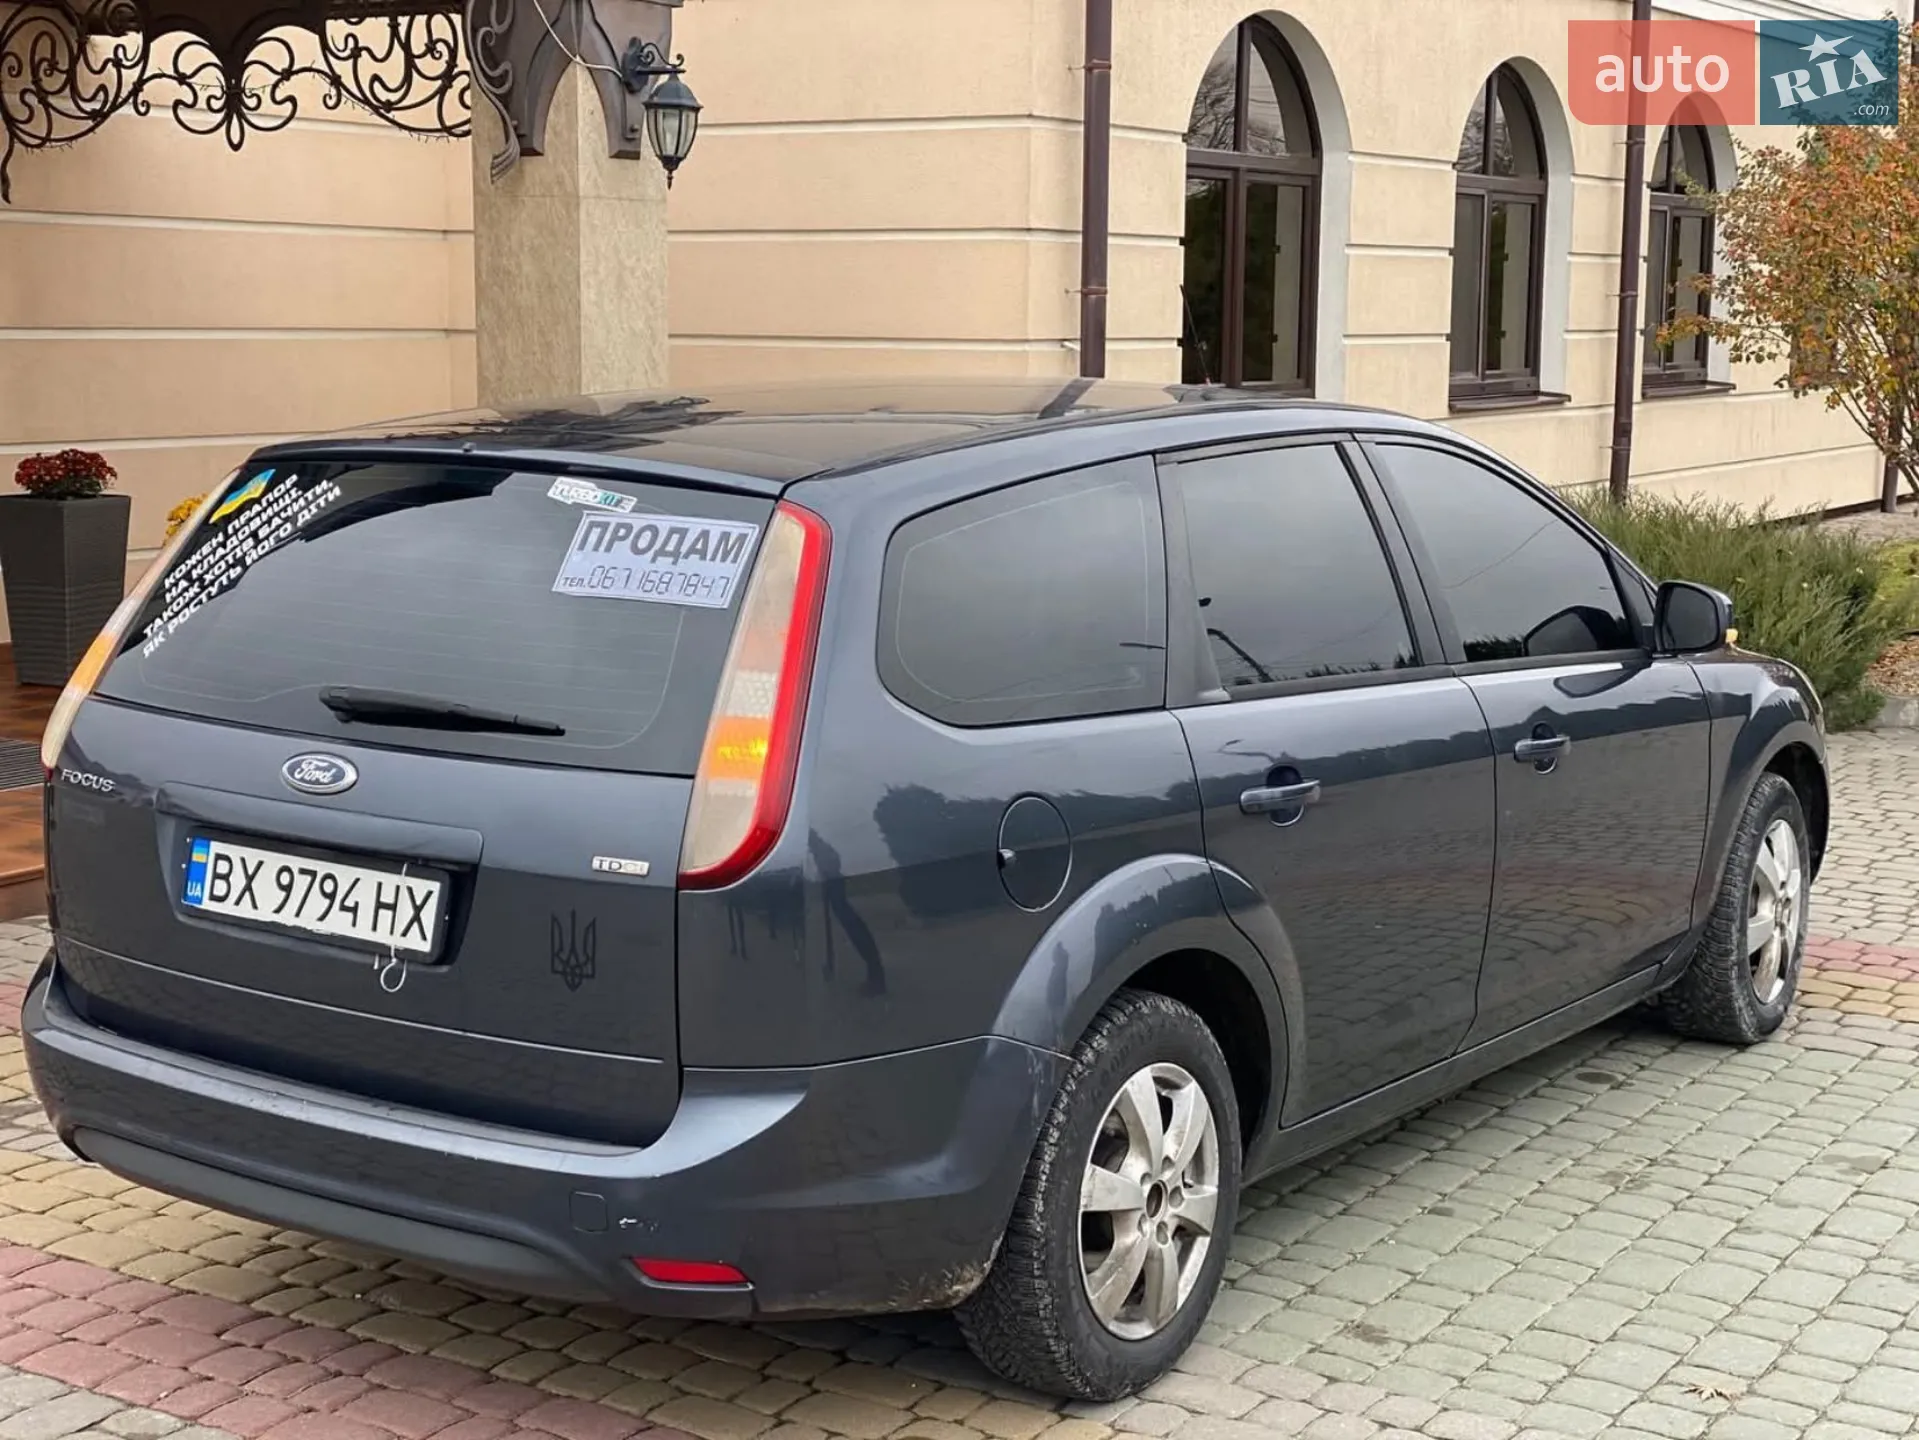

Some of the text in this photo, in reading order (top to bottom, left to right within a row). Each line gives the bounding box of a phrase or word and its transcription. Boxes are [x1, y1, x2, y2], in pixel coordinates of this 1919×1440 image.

[164, 474, 299, 589] КОЖЕН ПРАПОР
[576, 520, 750, 566] ПРОДАМ
[143, 480, 334, 638] ТАКОЖ ХОТІВ БАЧИТИ.
[143, 486, 342, 659] ЯК РОСТУТЬ ЙОГО ДІТИ
[164, 578, 188, 603] НА
[60, 768, 116, 792] FOCUS
[294, 758, 338, 784] Ford
[187, 882, 202, 898] UA
[208, 852, 434, 942] BX 9794 HX
